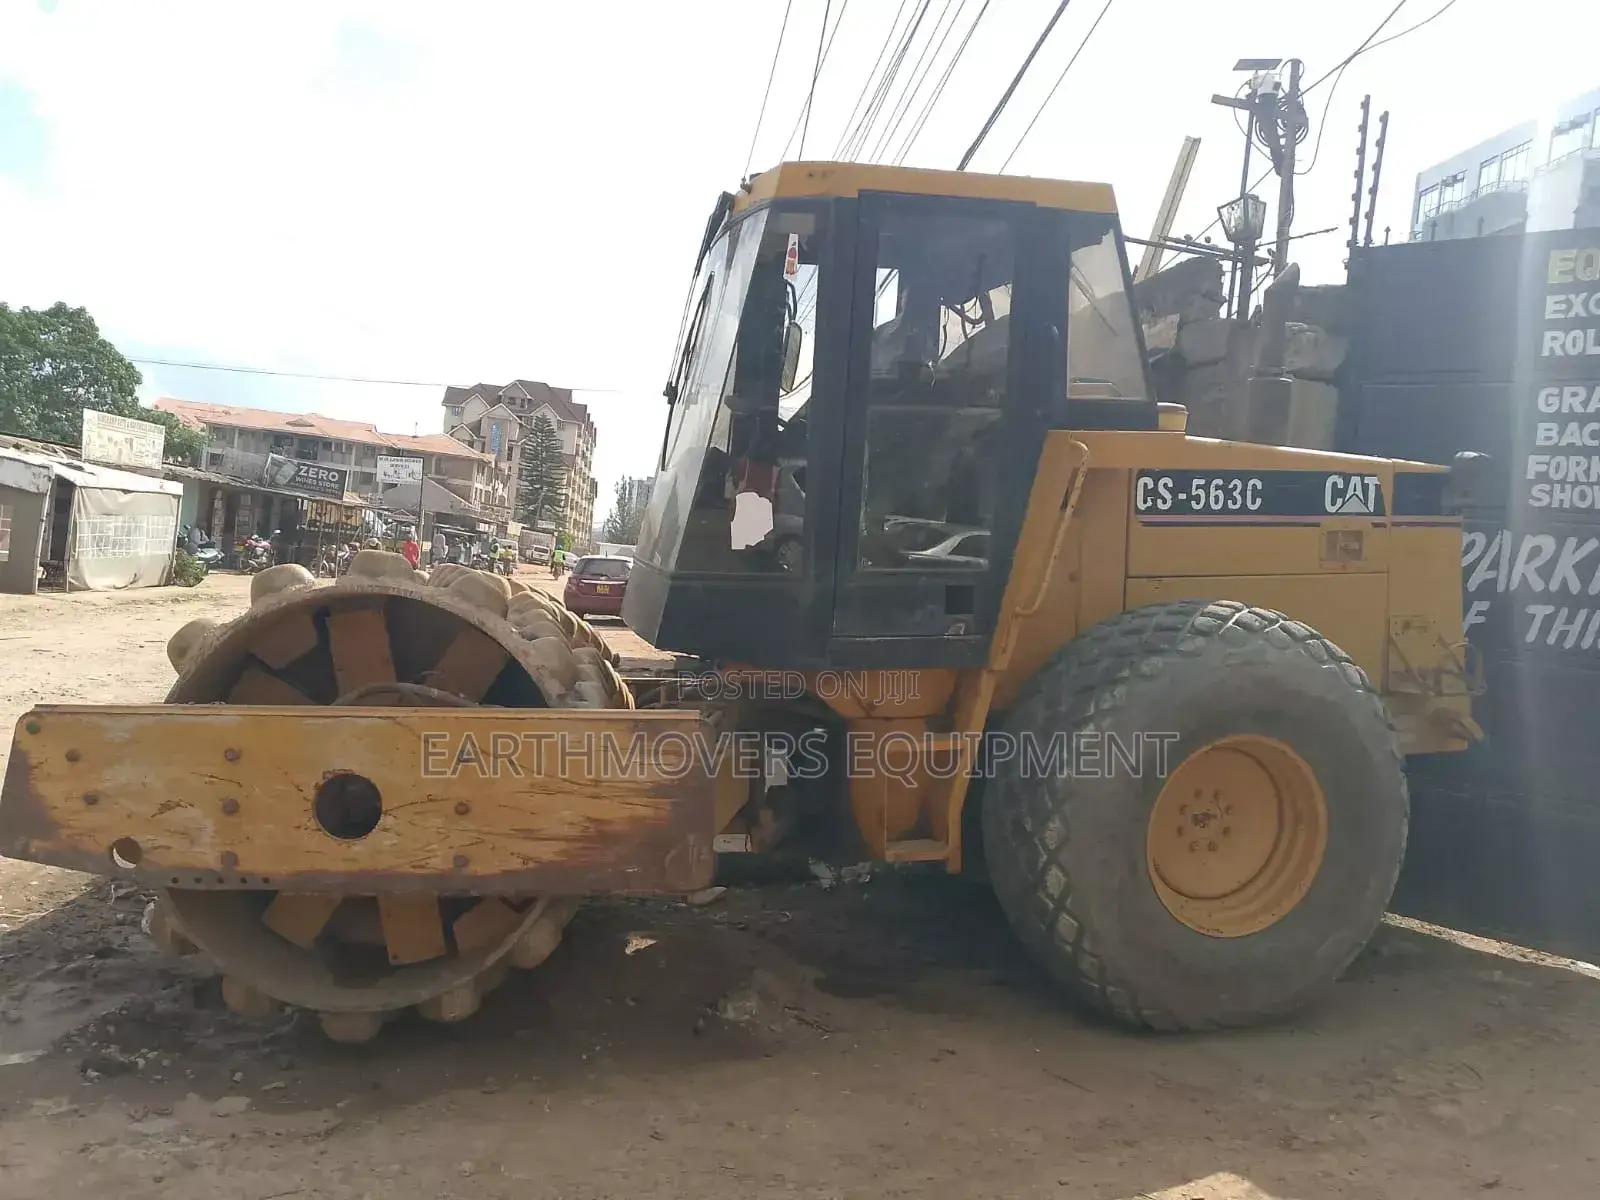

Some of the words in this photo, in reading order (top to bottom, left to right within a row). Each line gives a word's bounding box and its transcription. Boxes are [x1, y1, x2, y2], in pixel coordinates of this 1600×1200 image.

[299, 465, 339, 482] ZERO
[1136, 476, 1263, 511] CS-563C
[1325, 475, 1379, 513] CAT
[1525, 604, 1600, 650] THI
